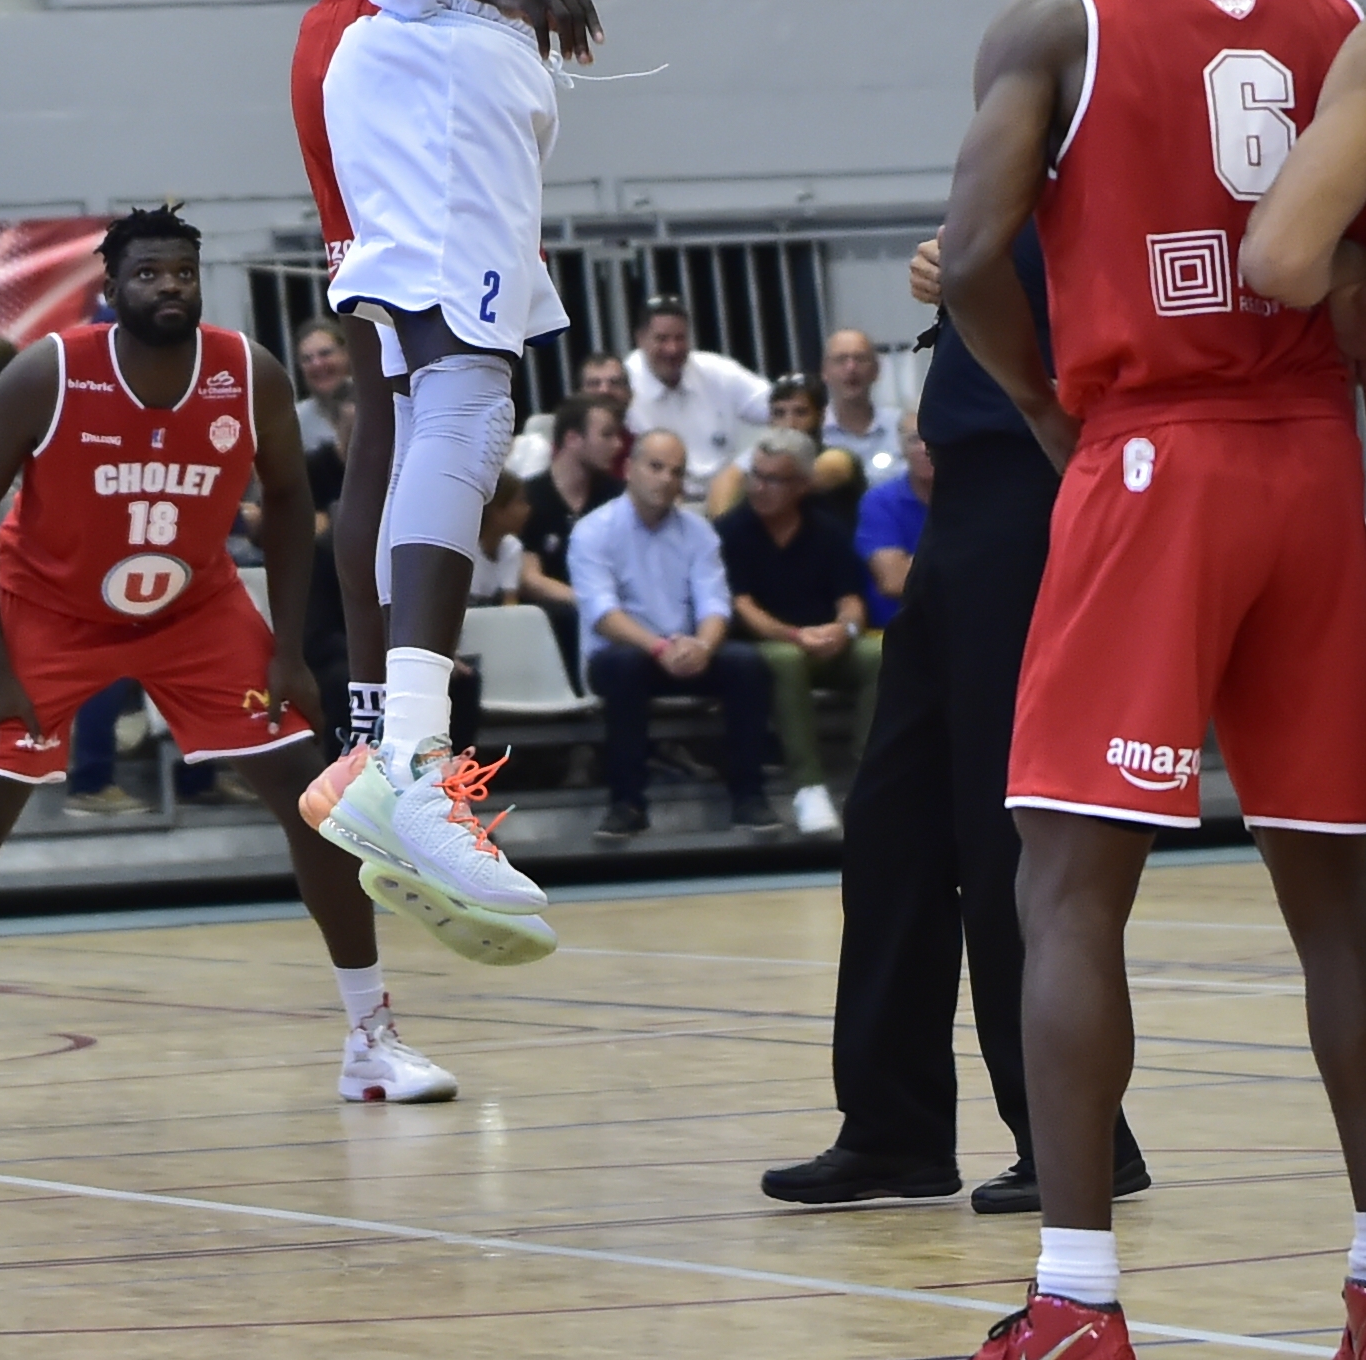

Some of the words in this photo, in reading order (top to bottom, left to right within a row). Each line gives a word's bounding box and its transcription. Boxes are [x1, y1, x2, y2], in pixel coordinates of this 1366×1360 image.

[1203, 48, 1297, 201] 6
[480, 270, 501, 324] 2
[94, 462, 222, 496] CHOLET
[1122, 437, 1156, 493] 6
[128, 501, 179, 545] 18
